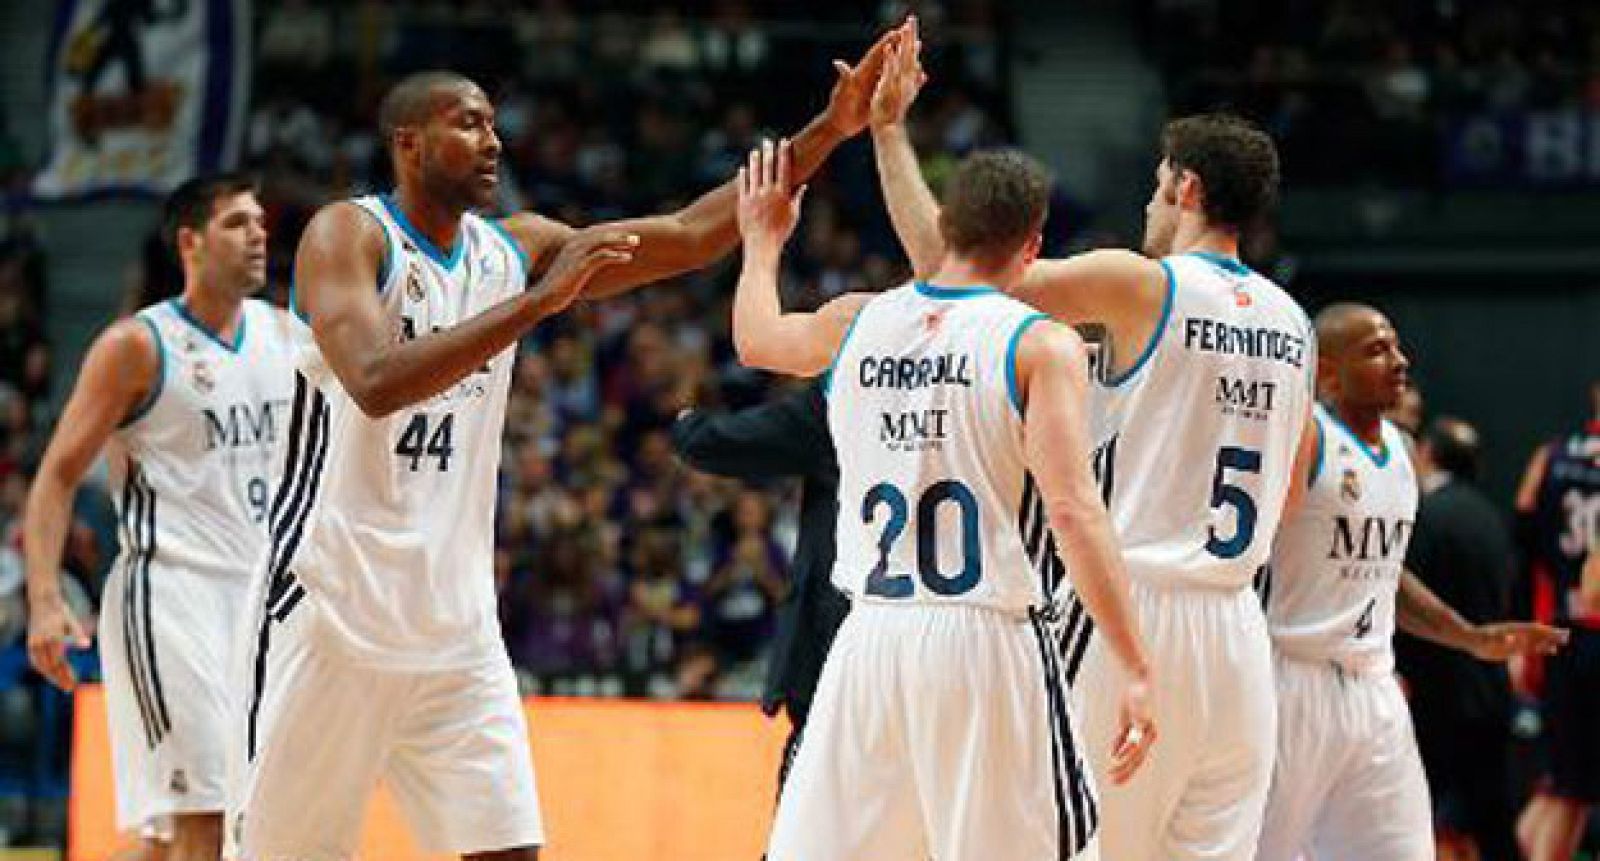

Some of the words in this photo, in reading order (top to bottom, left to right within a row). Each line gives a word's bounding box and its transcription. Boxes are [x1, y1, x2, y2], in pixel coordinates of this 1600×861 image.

[859, 354, 972, 389] CARROLL
[395, 413, 454, 471] 44
[881, 409, 948, 439] MMT
[247, 477, 267, 522] 9
[1205, 446, 1262, 559] 5
[861, 482, 984, 597] 20
